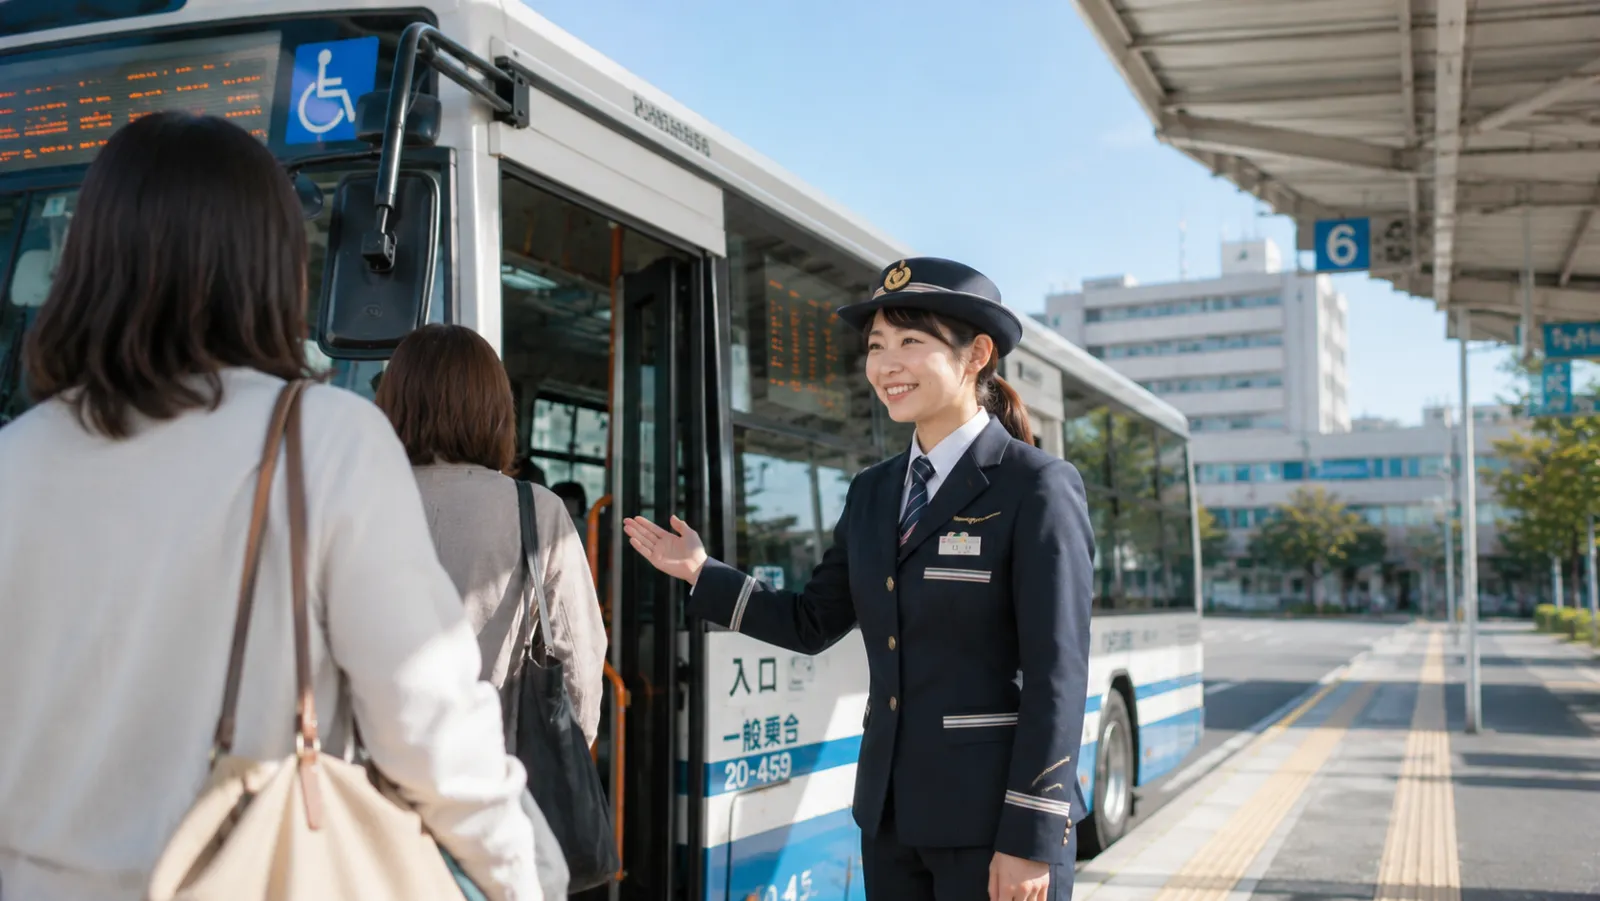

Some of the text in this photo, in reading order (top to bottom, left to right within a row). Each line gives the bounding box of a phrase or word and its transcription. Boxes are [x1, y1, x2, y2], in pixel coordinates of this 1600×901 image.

[1326, 224, 1358, 266] 6
[729, 657, 777, 696] 入口
[723, 714, 799, 752] 一般乗合
[724, 752, 792, 790] 20-459
